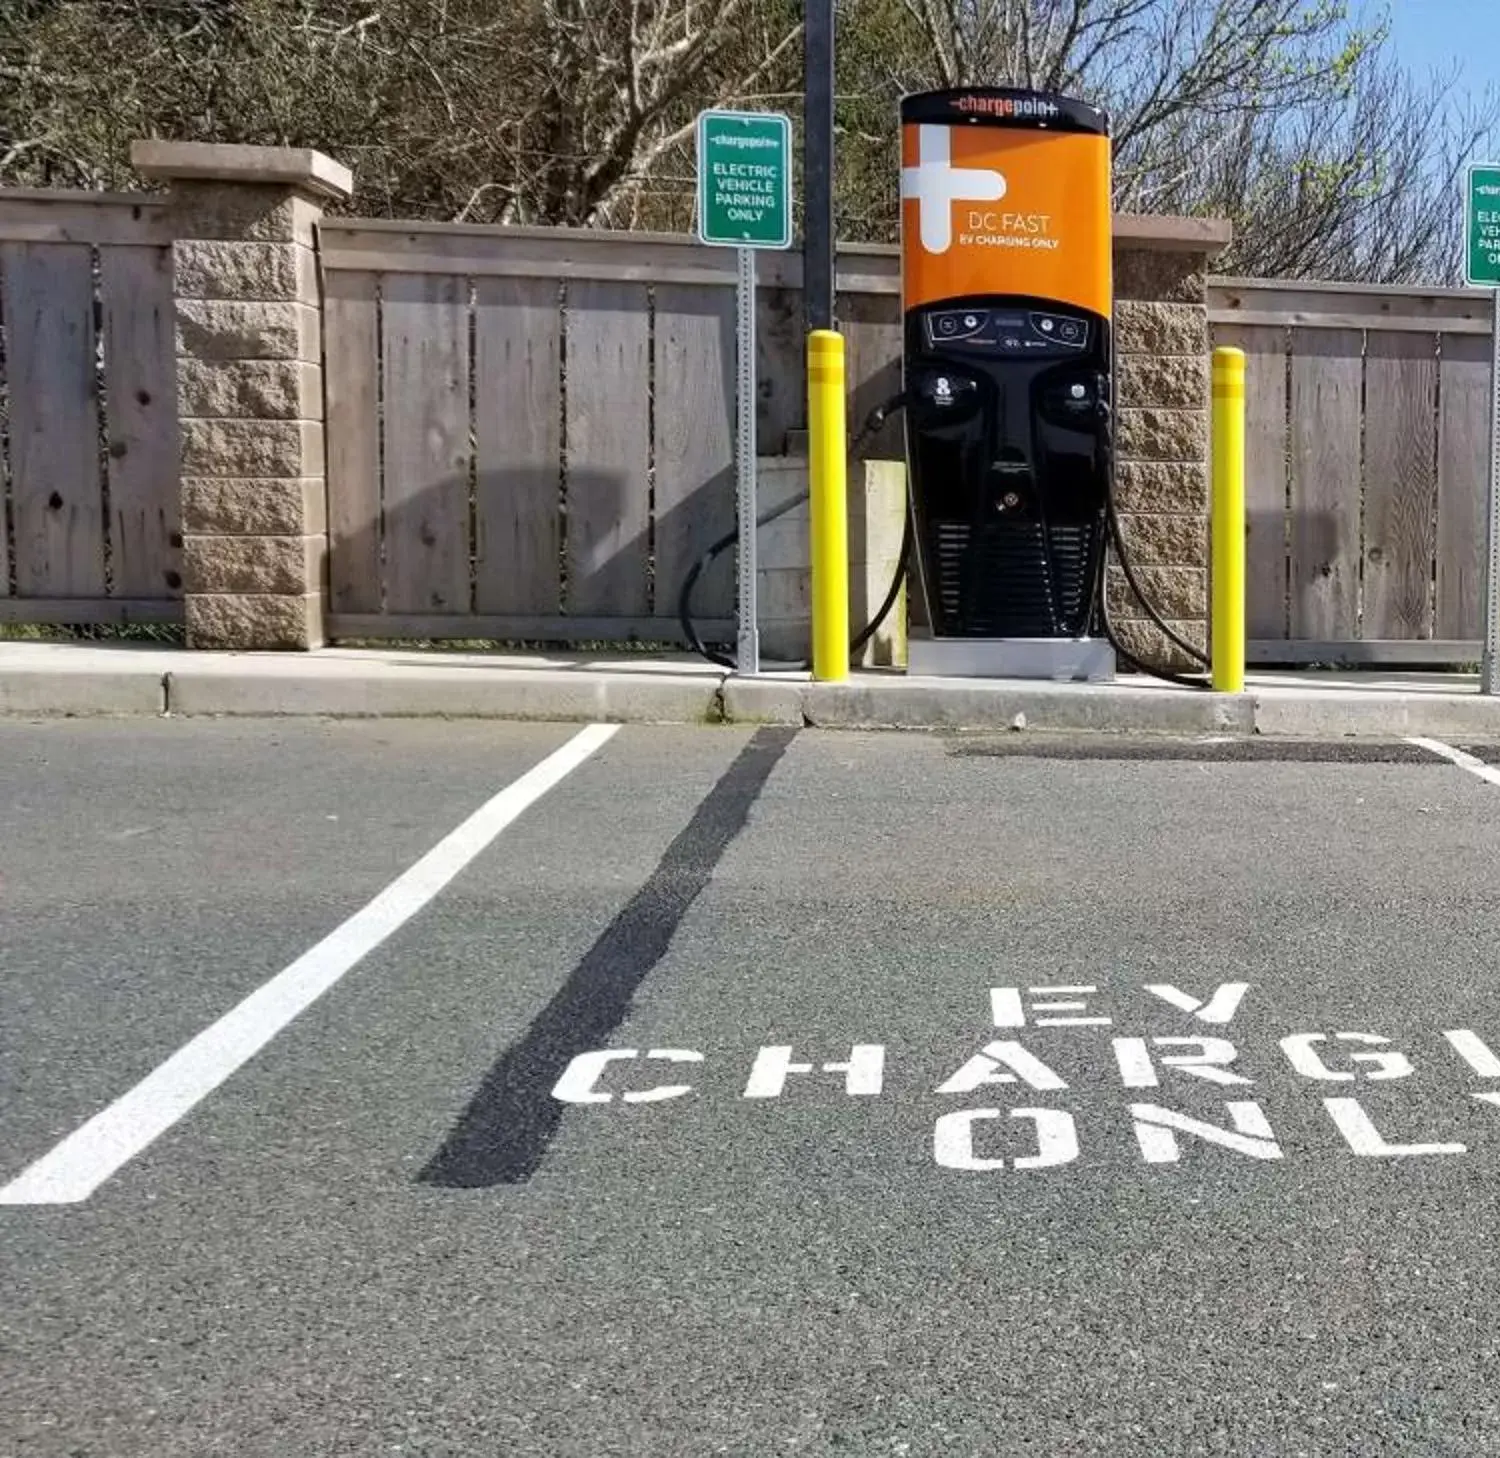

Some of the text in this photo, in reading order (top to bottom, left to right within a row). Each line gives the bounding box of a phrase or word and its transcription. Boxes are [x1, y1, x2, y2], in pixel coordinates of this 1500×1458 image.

[713, 162, 777, 178] ELECTRIC
[717, 178, 775, 193] VEHICLE
[715, 193, 776, 208] PARKING
[727, 208, 764, 221] ONLY
[968, 211, 1051, 234] DC FAST
[959, 234, 1060, 249] EV CHARGING ONLY
[990, 983, 1250, 1027] EV
